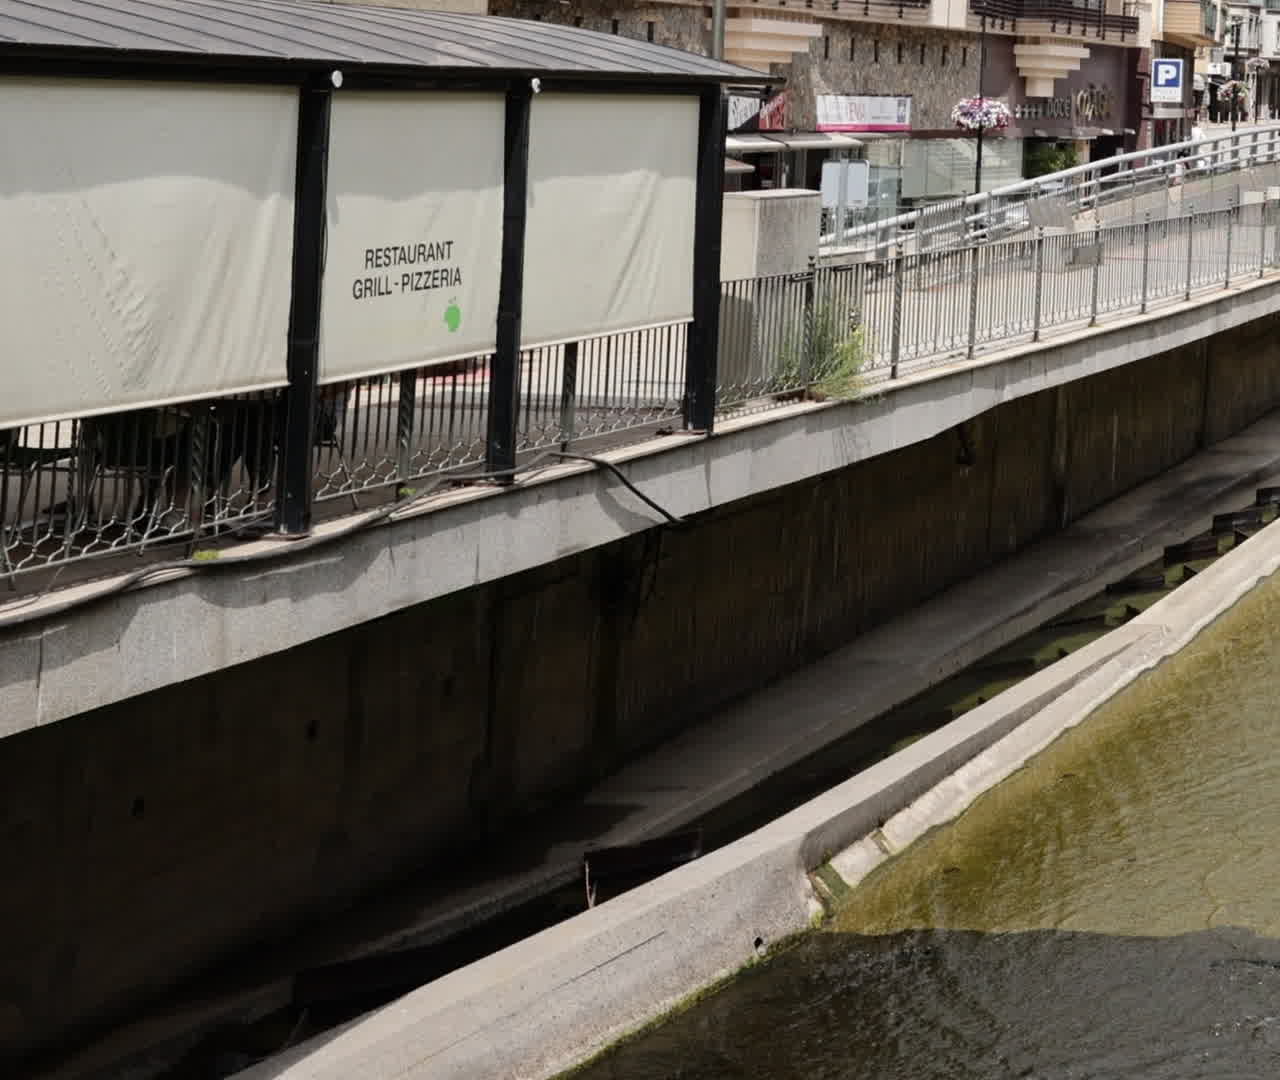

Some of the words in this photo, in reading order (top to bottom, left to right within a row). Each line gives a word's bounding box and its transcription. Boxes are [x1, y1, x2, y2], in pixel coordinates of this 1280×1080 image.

[1158, 64, 1177, 85] P
[364, 240, 454, 269] RESTAURANT
[401, 266, 462, 293] PIZZERIA
